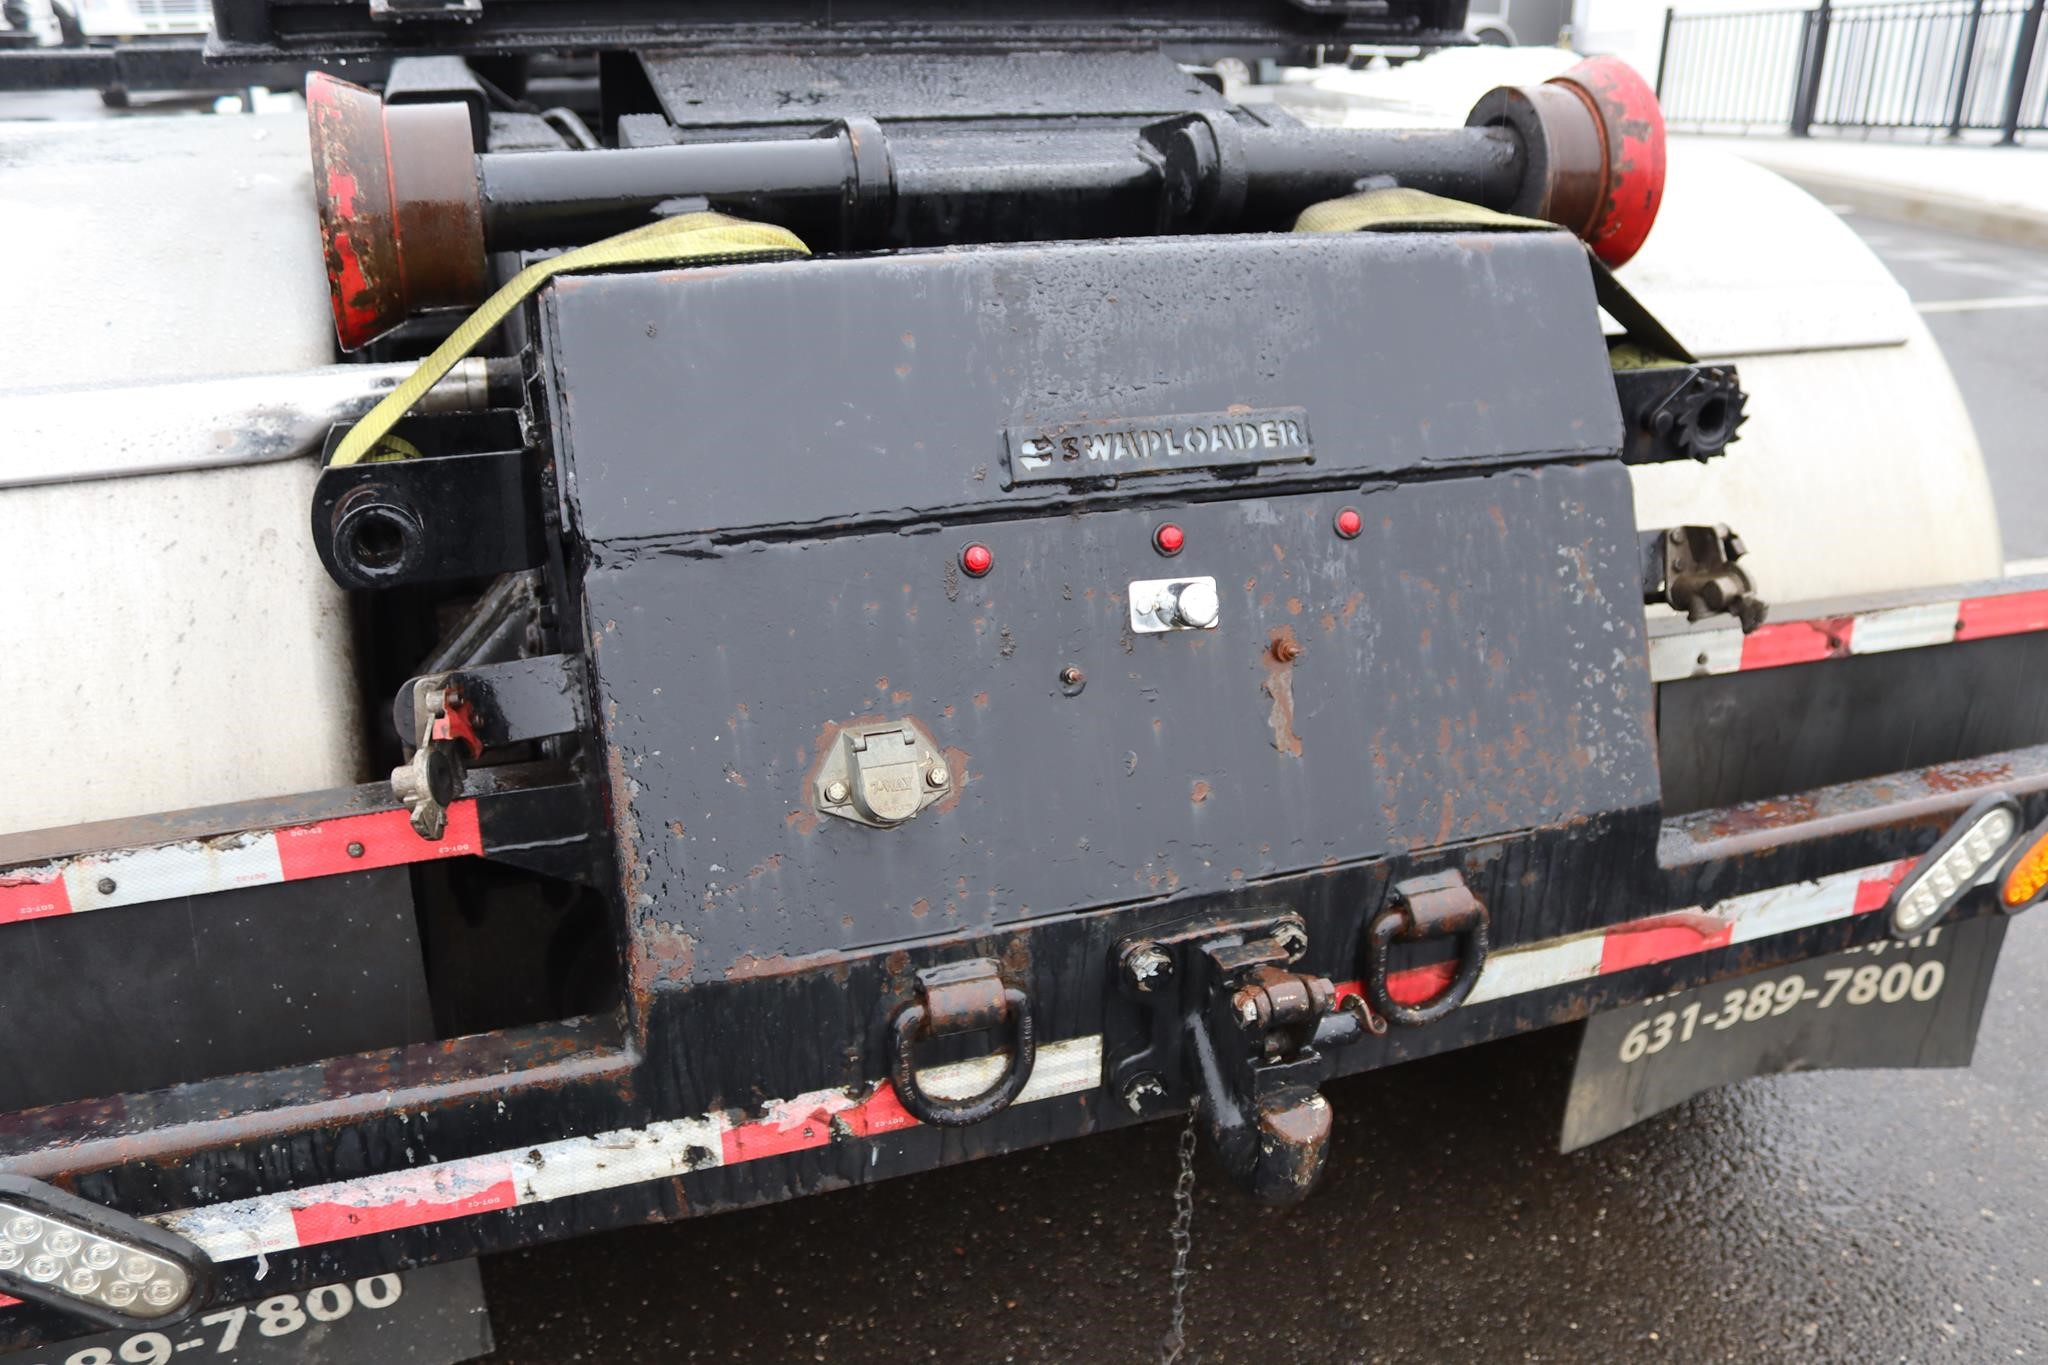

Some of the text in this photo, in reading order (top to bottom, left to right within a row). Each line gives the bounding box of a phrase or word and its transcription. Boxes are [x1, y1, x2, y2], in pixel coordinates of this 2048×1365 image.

[1061, 419, 1302, 462] SWAPLOADER
[438, 843, 470, 853] DOT-C2
[19, 903, 55, 914] DOT-C2
[1618, 959, 1945, 1064] 631-389-7800
[875, 1116, 905, 1127] DOT-C2
[468, 1197, 500, 1208] DOT-C2
